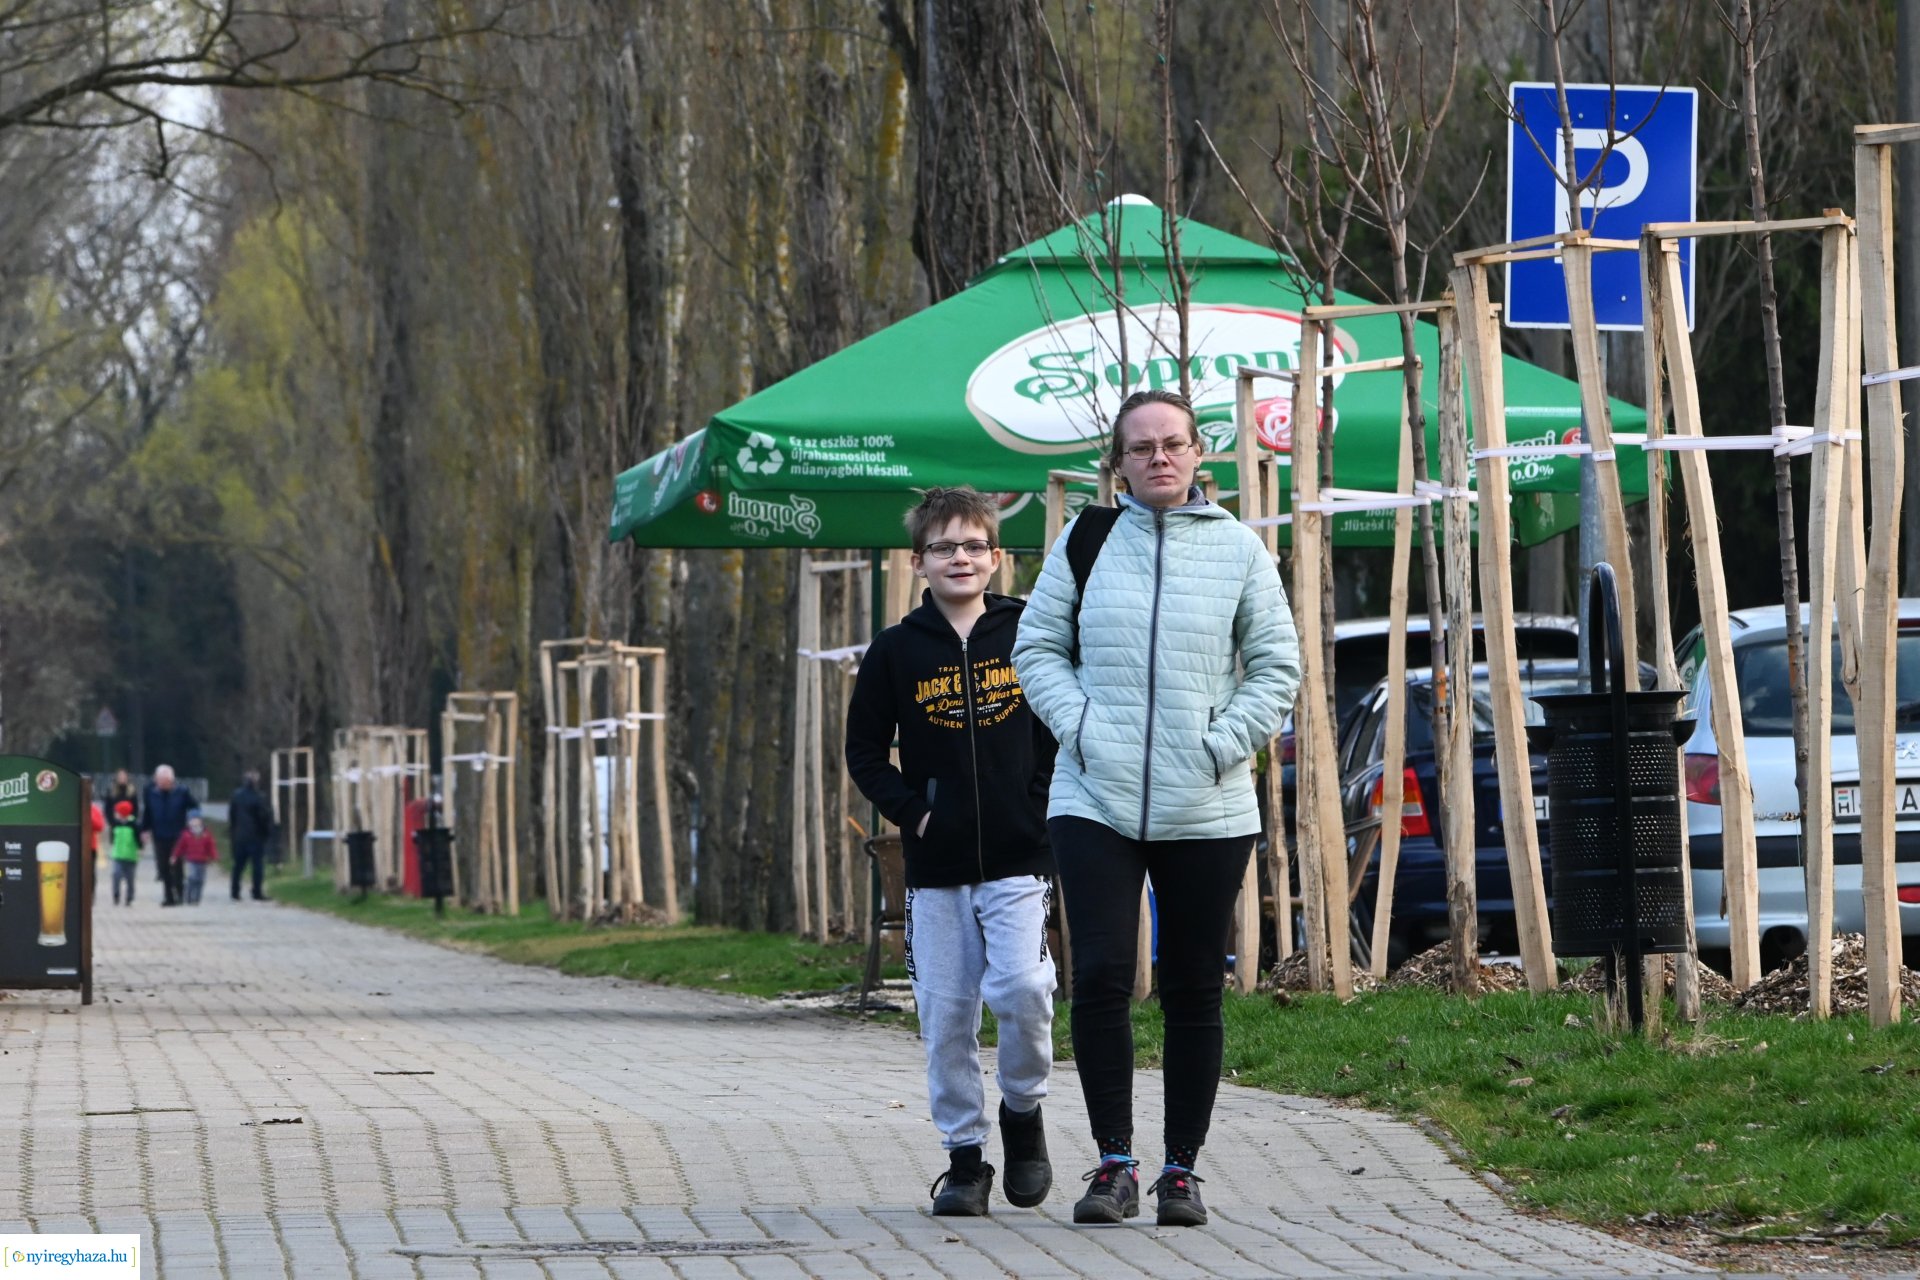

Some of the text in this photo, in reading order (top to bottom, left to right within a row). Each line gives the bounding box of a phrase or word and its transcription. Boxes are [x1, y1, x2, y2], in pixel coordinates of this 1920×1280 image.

[1554, 128, 1649, 264] P
[804, 438, 818, 449] az
[820, 435, 860, 449] eszköz
[862, 434, 895, 448] 100%
[790, 462, 913, 478] műanyagból készült.
[1511, 462, 1555, 481] 0.0%
[915, 676, 952, 703] JACK
[981, 666, 1020, 691] JONE
[994, 696, 1021, 723] SUPPLY
